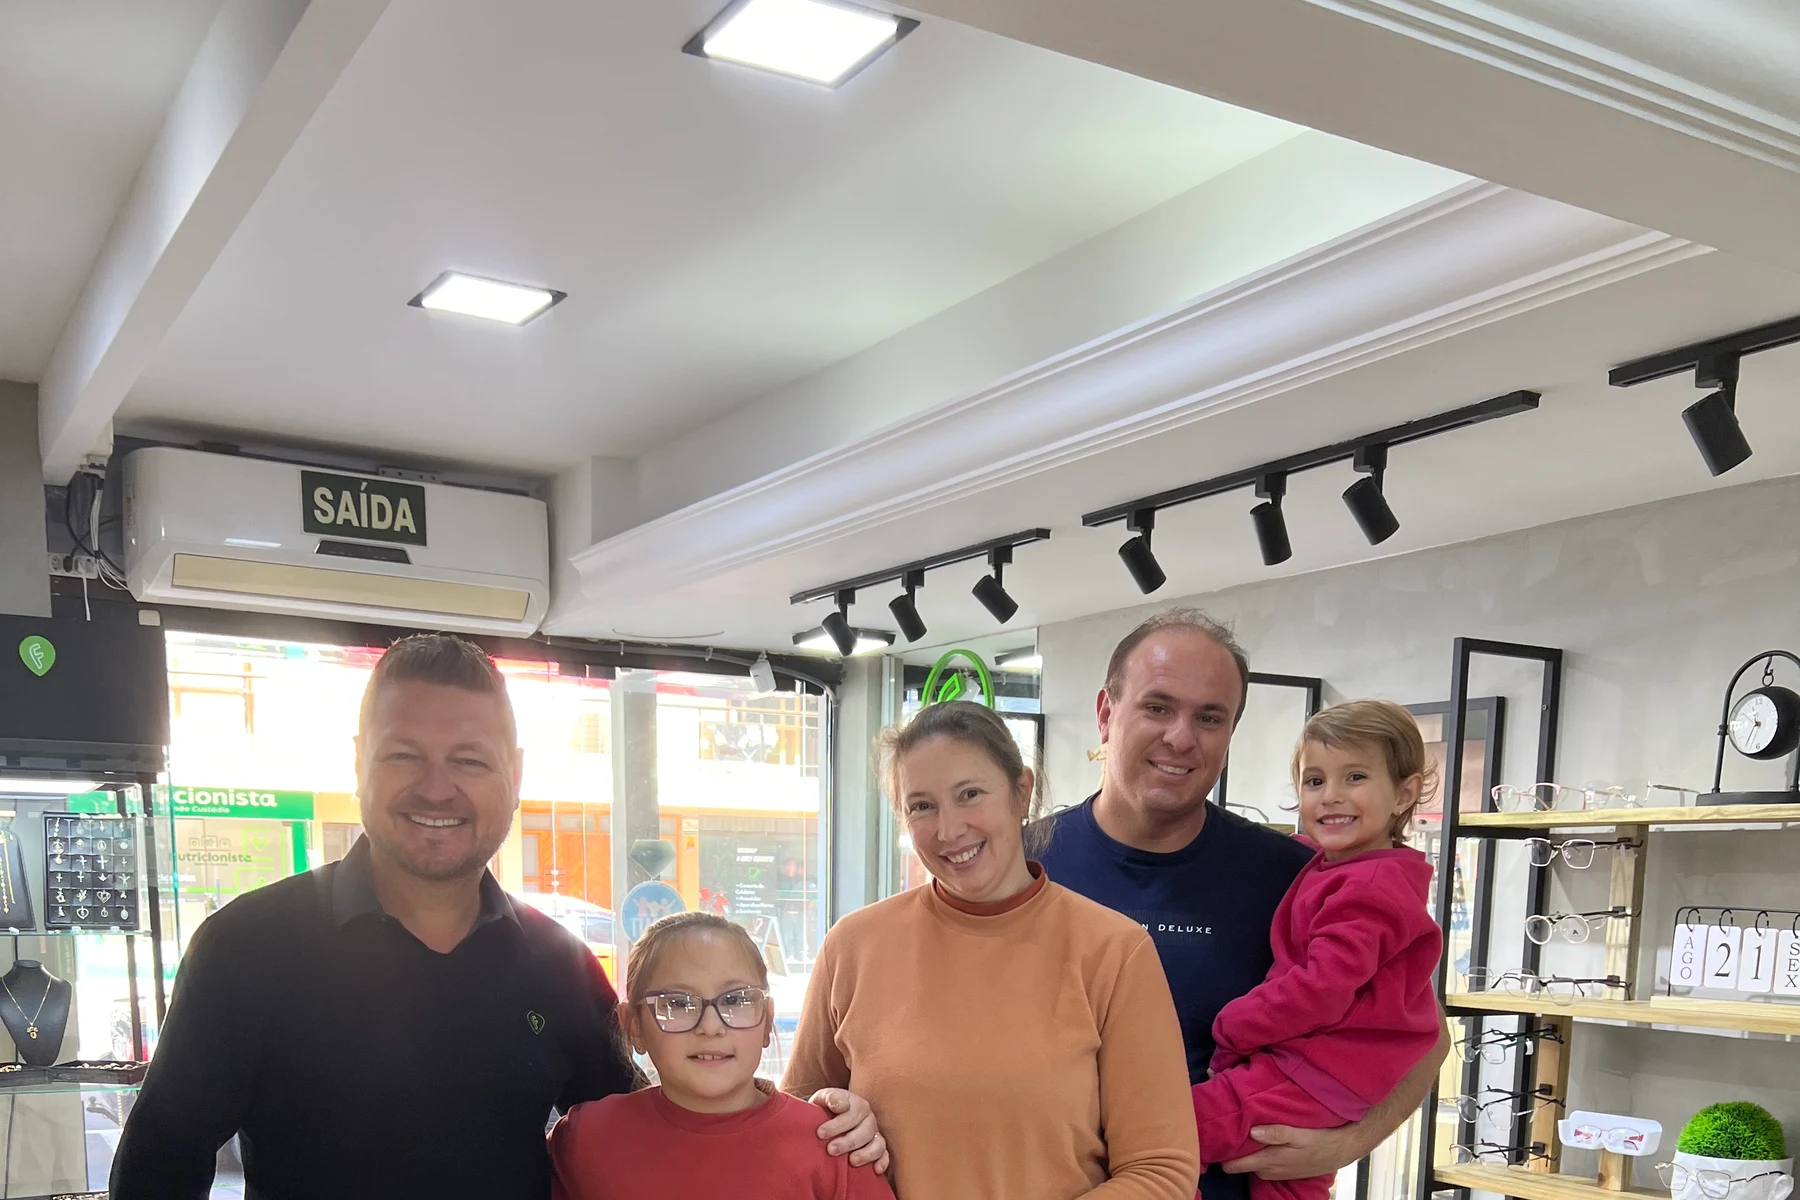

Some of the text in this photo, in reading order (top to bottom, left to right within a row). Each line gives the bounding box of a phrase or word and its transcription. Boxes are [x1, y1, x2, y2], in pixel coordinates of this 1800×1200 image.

[313, 482, 417, 534] SAÍDA
[173, 787, 278, 808] cionista
[1158, 923, 1213, 935] DELUXE
[1680, 936, 1694, 980] AGO
[1785, 942, 1800, 988] SEX
